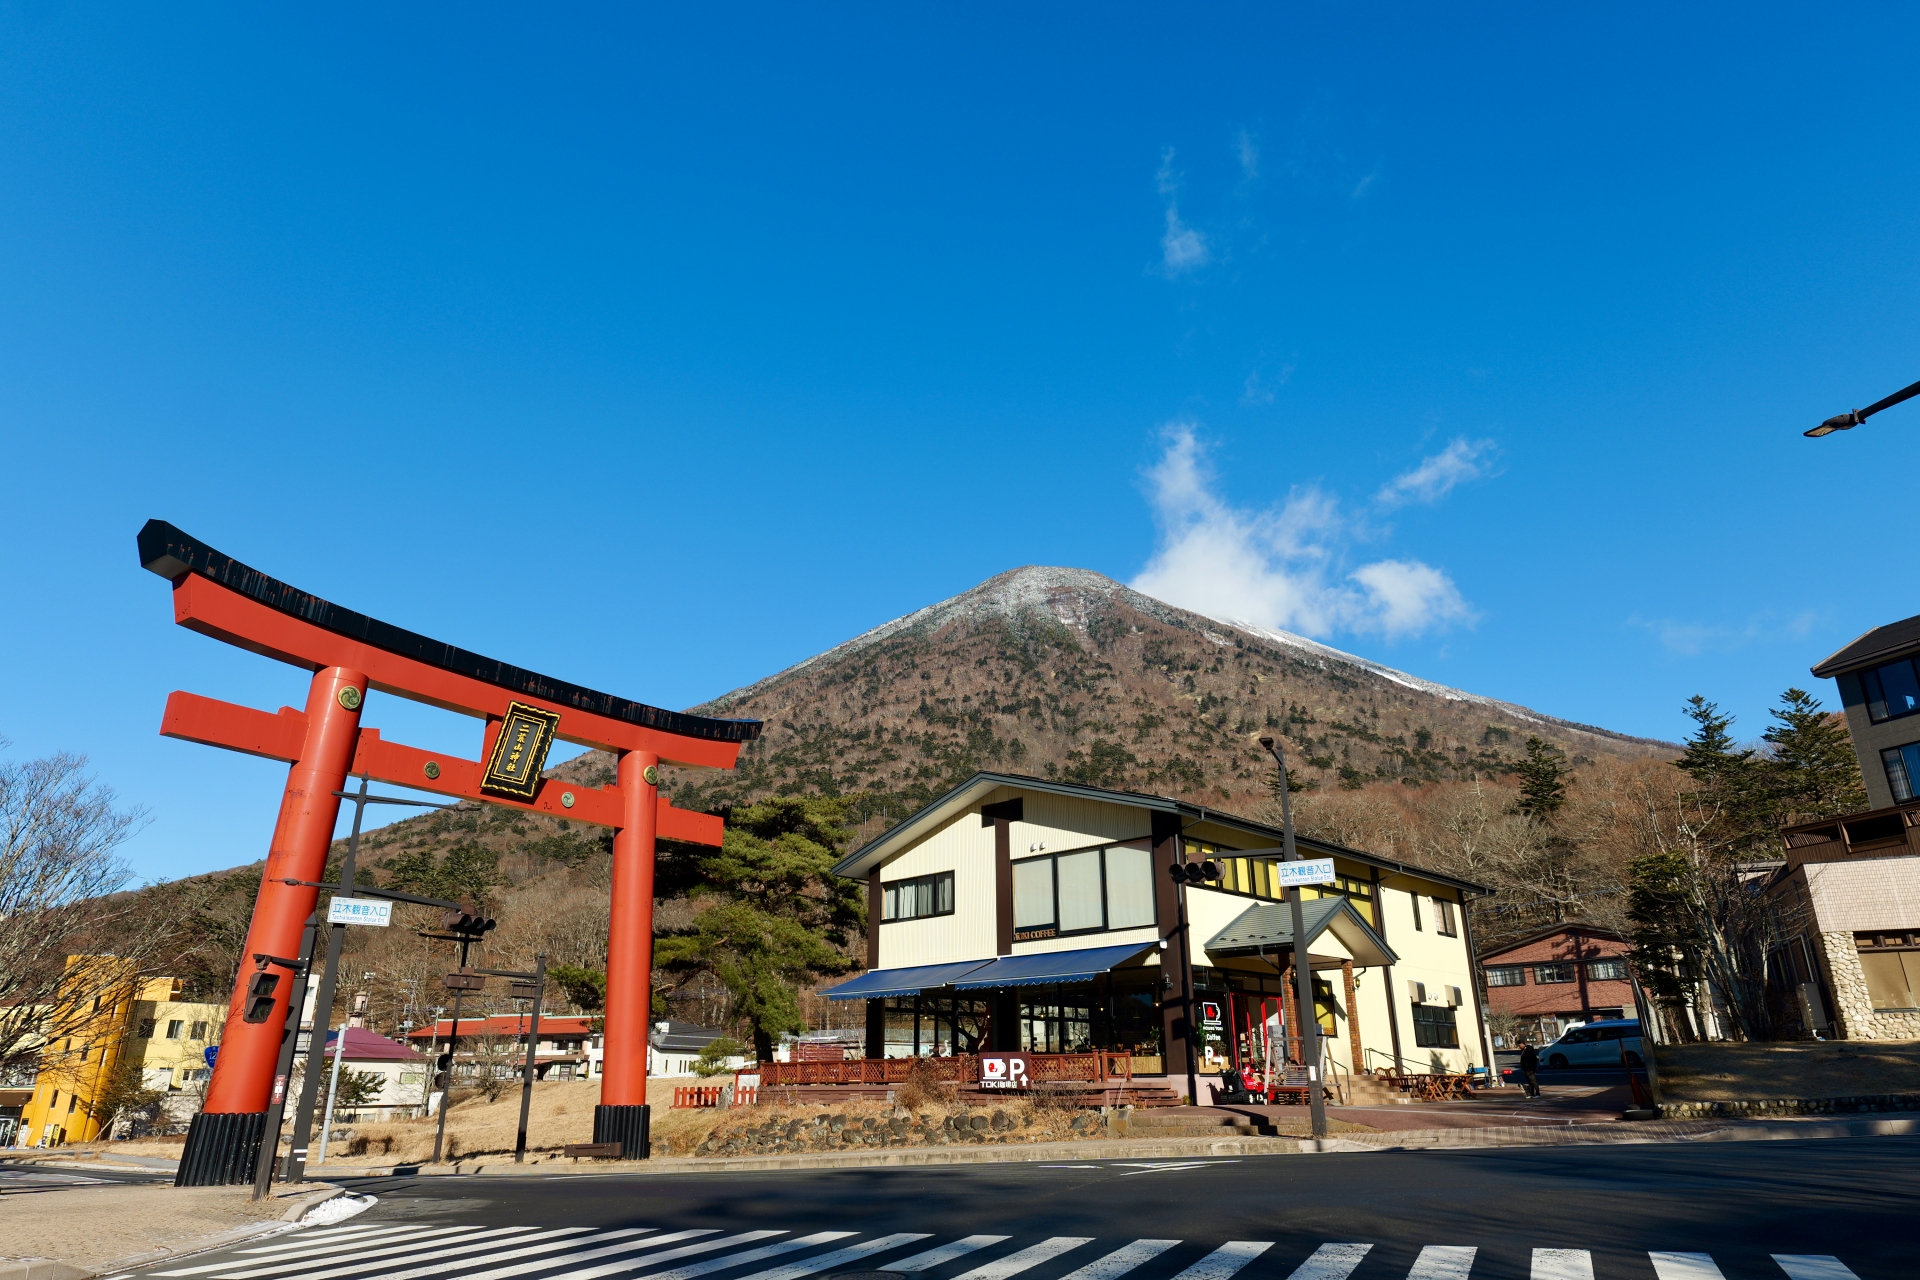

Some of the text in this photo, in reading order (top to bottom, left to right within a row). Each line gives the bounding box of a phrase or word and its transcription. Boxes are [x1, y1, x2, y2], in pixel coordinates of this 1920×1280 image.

[506, 724, 530, 772] 二荒山神社
[1281, 864, 1332, 877] 立木観音入口
[333, 903, 388, 917] 立木観音入口
[1030, 928, 1056, 938] COFFEE
[1206, 1033, 1221, 1041] Coffee
[1204, 1045, 1214, 1065] P
[1009, 1058, 1026, 1081] P
